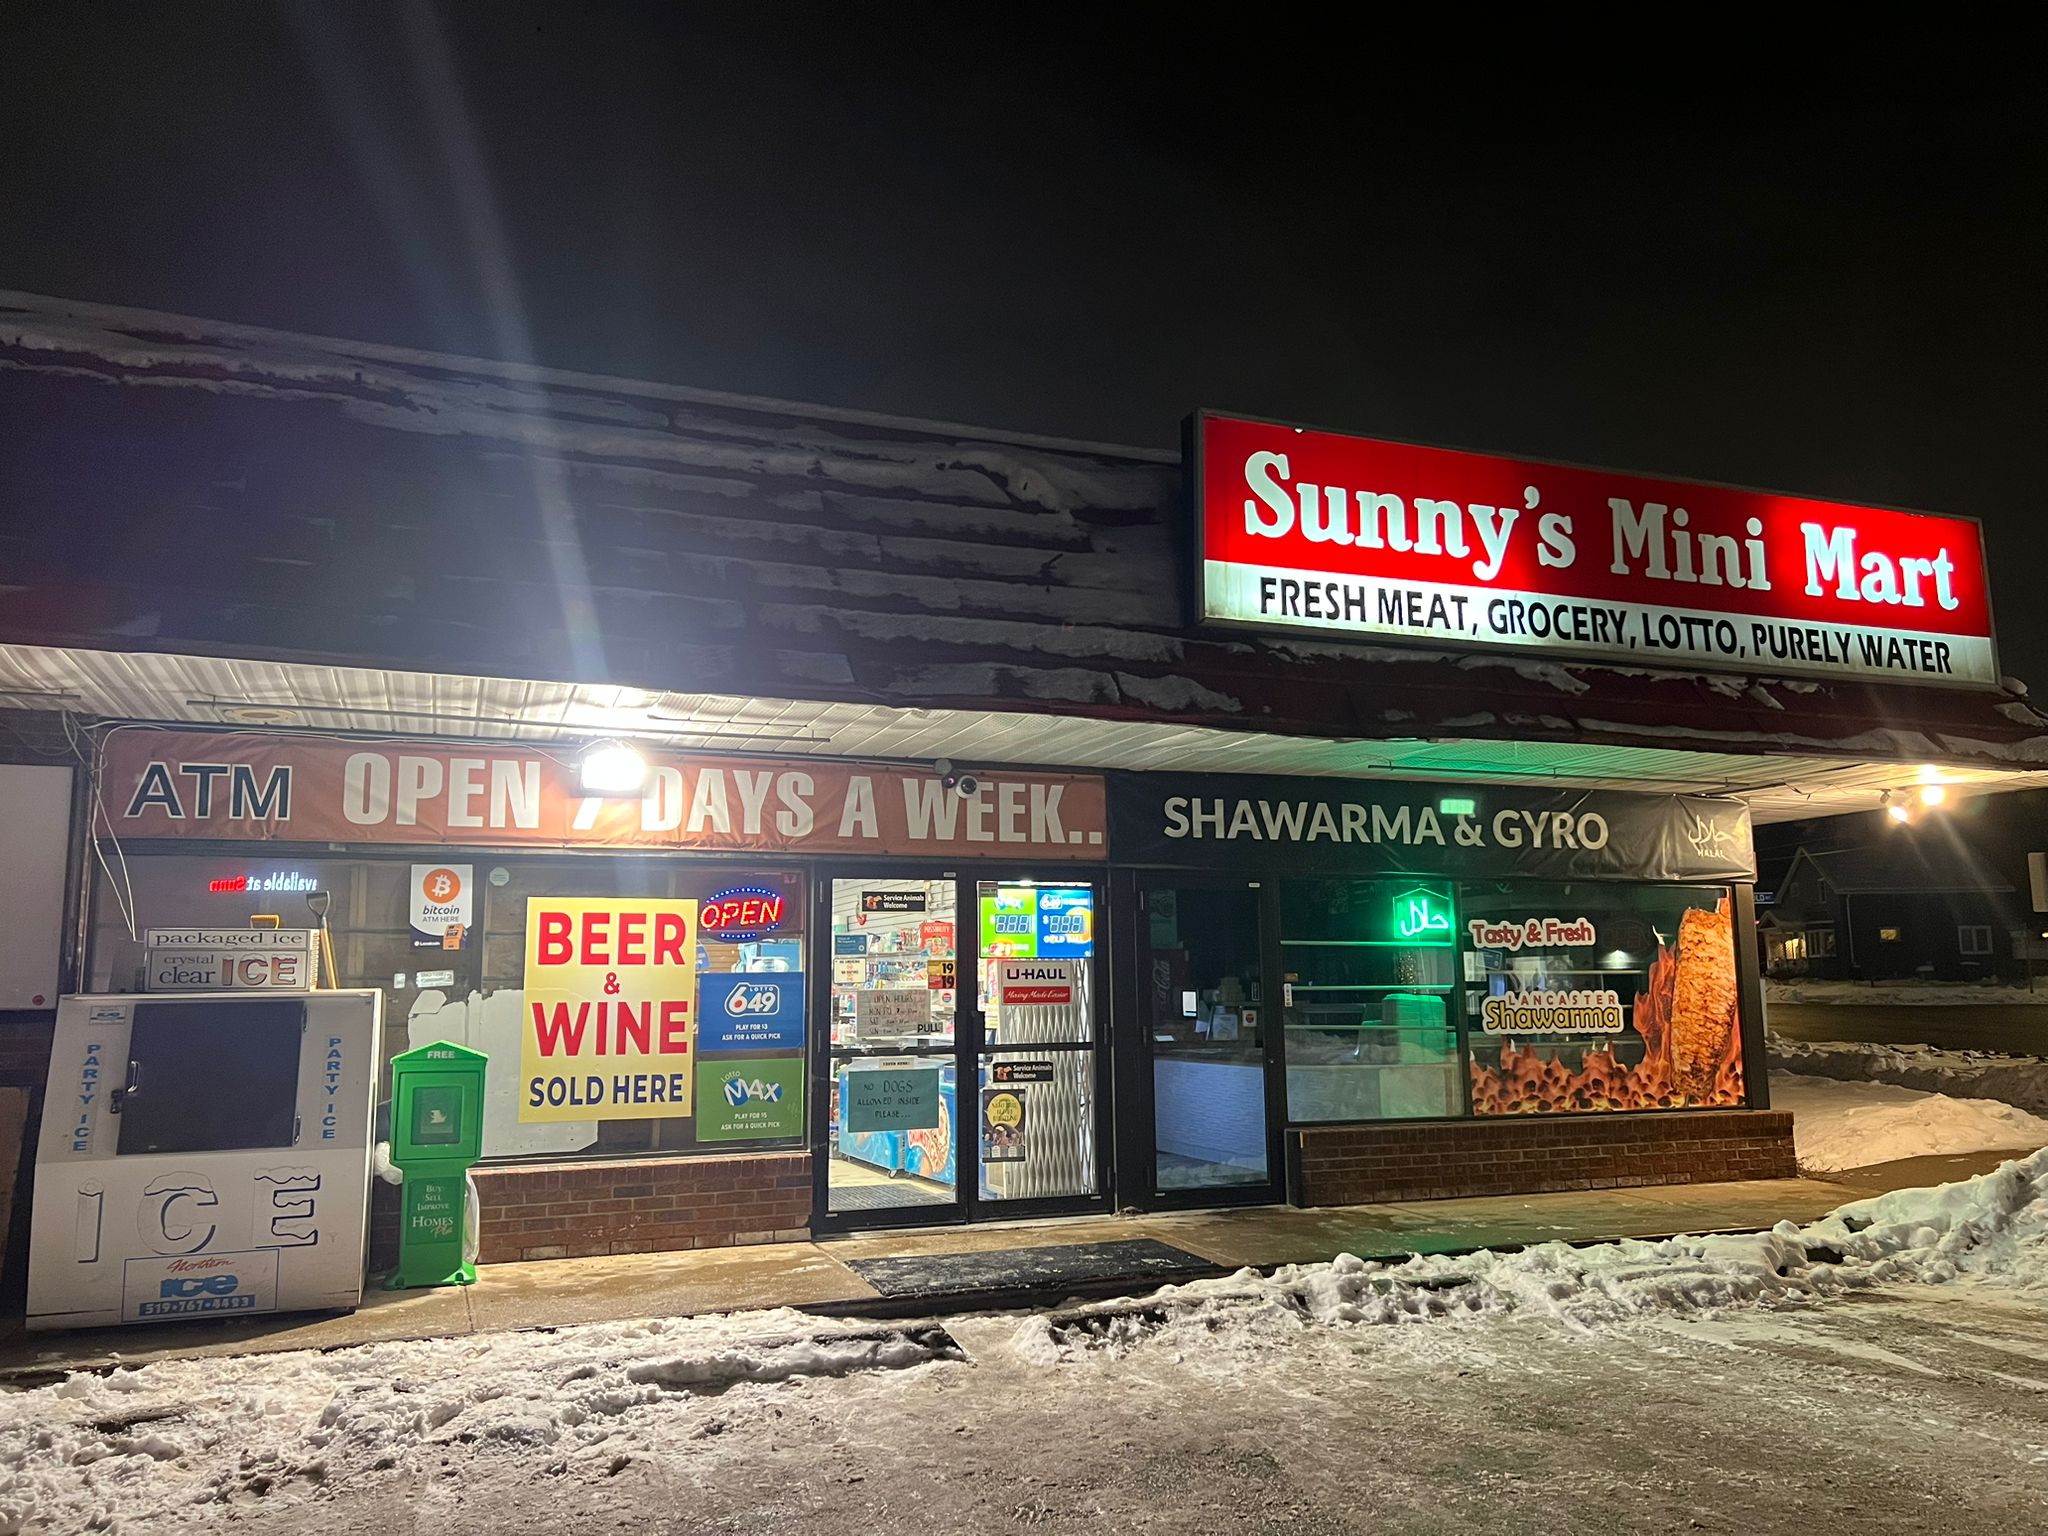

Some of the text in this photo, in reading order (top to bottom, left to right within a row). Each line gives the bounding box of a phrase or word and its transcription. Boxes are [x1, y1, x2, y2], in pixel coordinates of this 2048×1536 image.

[1244, 450, 1959, 611] Sunny's Mini Mart
[1260, 577, 1953, 674] FRESH MEAT, GROCERY, LOTTO, PURELY WATER
[124, 761, 293, 821] ATM
[342, 752, 540, 829] OPEN
[640, 766, 814, 838] DAYS
[838, 775, 879, 839] A
[902, 777, 1102, 845] WEEK..
[1163, 797, 1609, 851] SHAWARMA & GYRO
[1698, 848, 1724, 858] HALAL
[422, 905, 460, 915] bitcoin
[700, 896, 781, 929] OPEN
[883, 894, 925, 902] Service Animals
[1400, 899, 1448, 937] حلال
[1472, 918, 1592, 947] Tasty & Fresh
[155, 933, 302, 946] packaged ice
[537, 912, 687, 966] BEER
[159, 953, 298, 986] clear ICE
[163, 955, 214, 965] crystal
[942, 963, 954, 974] 19
[1007, 968, 1067, 980] U-HAUL
[603, 972, 621, 995] &
[942, 976, 955, 989] 19
[728, 986, 776, 1013] 649
[1509, 993, 1617, 1006] LANCASTER
[531, 1001, 689, 1057] WINE
[917, 1023, 940, 1033] PULL
[1485, 1000, 1621, 1031] Shawarma
[325, 1038, 342, 1096] PARTY
[427, 1051, 455, 1059] FREE
[1012, 1064, 1031, 1072] Service
[79, 1044, 101, 1105] PARTY
[720, 1070, 741, 1083] Lotto
[864, 1080, 913, 1093] NO DOGS
[529, 1074, 684, 1107] SOLD HERE
[724, 1078, 780, 1107] MAX
[857, 1097, 920, 1106] ALLOWED INSIDE
[73, 1113, 90, 1152] ICE
[322, 1104, 337, 1140] ICE
[76, 1165, 322, 1264] ICE
[166, 1257, 236, 1273] Northern
